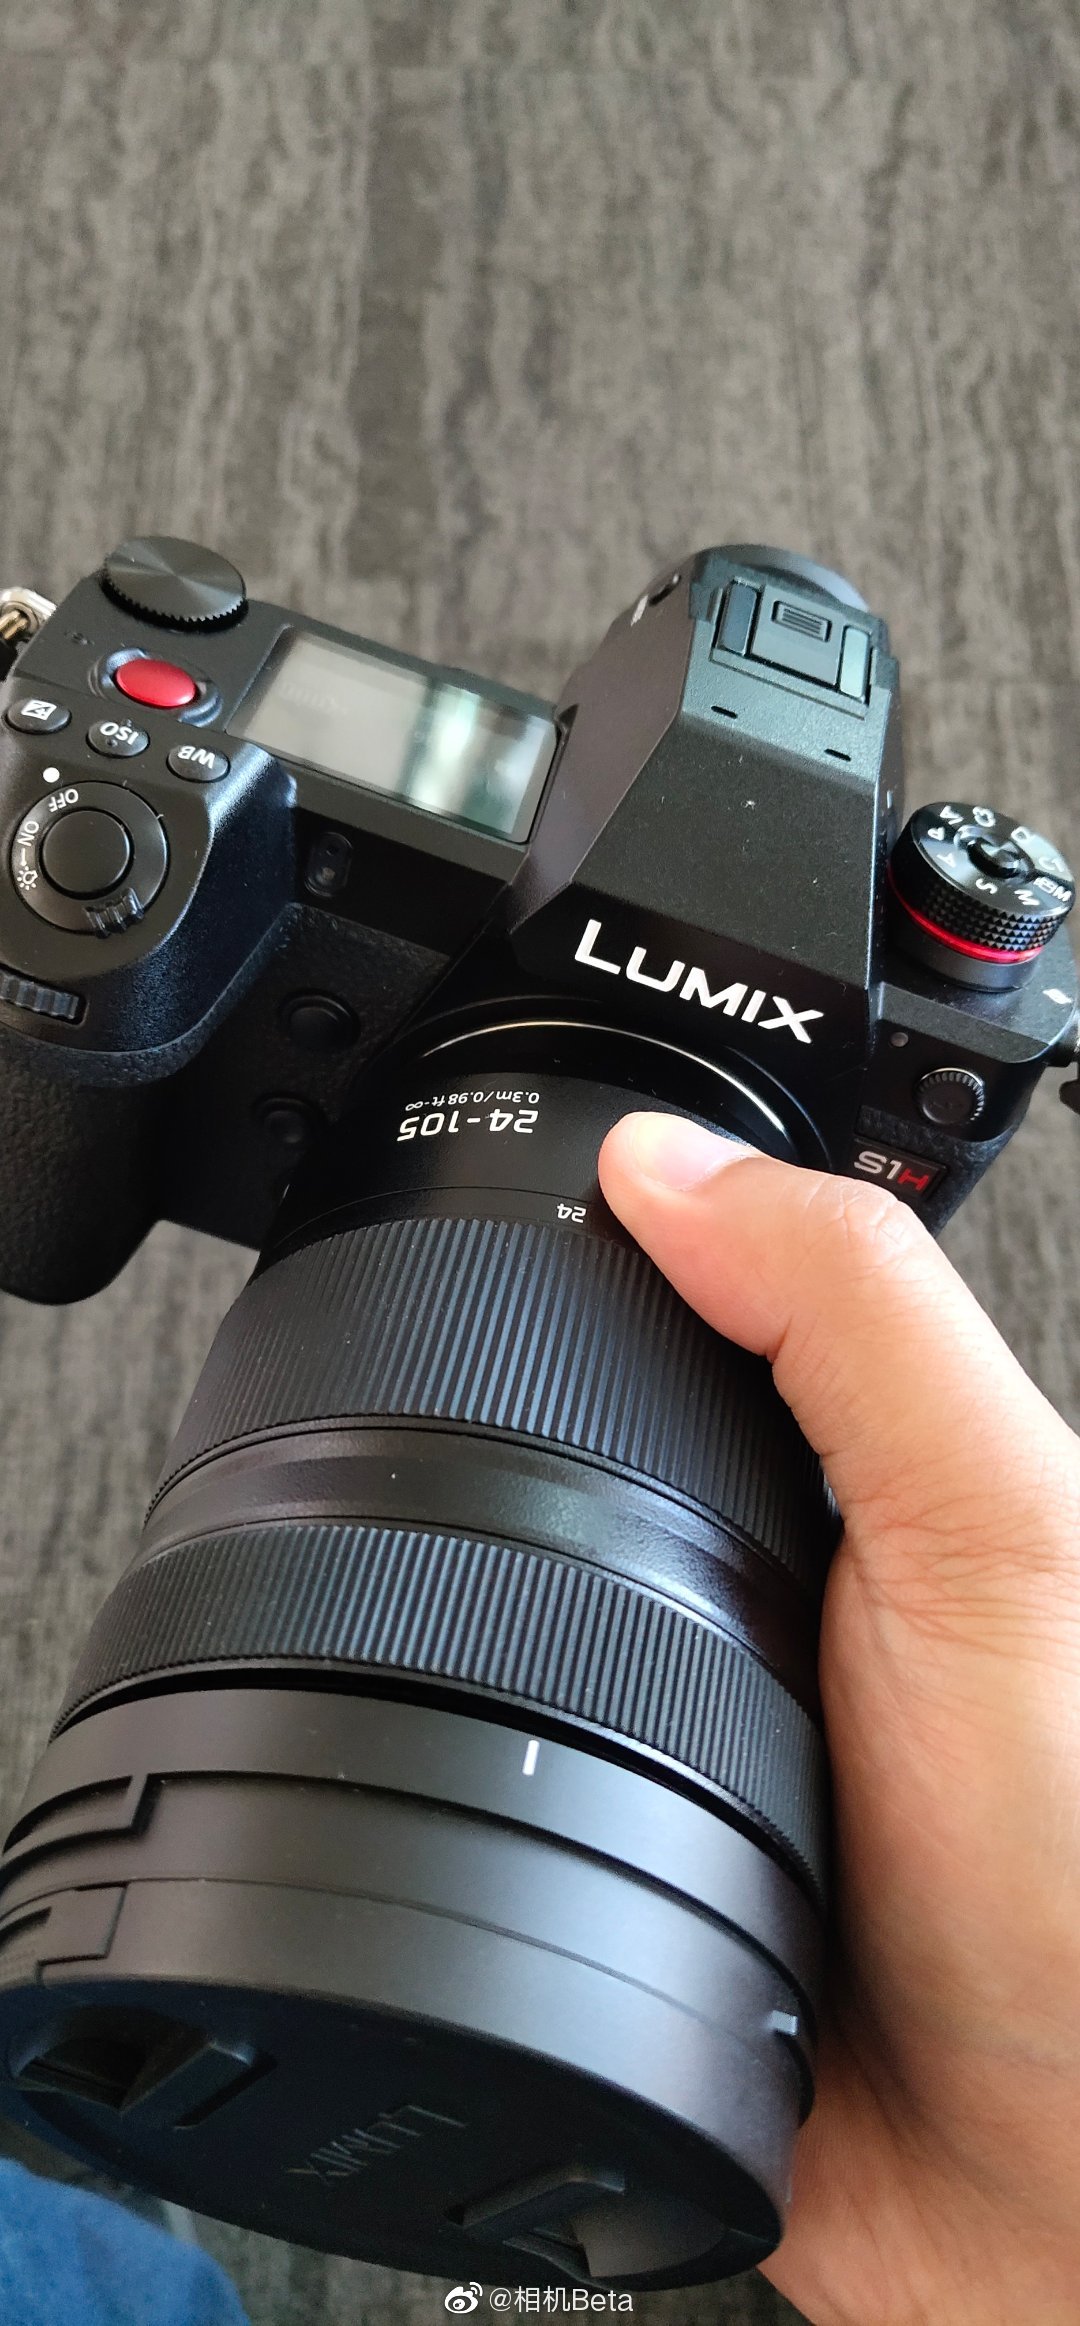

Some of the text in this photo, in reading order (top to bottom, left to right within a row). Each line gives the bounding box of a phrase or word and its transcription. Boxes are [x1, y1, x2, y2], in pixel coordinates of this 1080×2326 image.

[100, 721, 140, 745] ISO
[177, 745, 216, 769] WB
[48, 788, 79, 812] OFF
[17, 820, 39, 847] ON
[927, 826, 945, 841] P
[936, 852, 957, 868] A
[975, 878, 998, 894] S
[1014, 889, 1040, 906] M
[574, 919, 824, 1044] LUMIX
[396, 1108, 539, 1142] 24-105
[854, 1150, 929, 1191] S1H
[556, 1203, 587, 1224] 24
